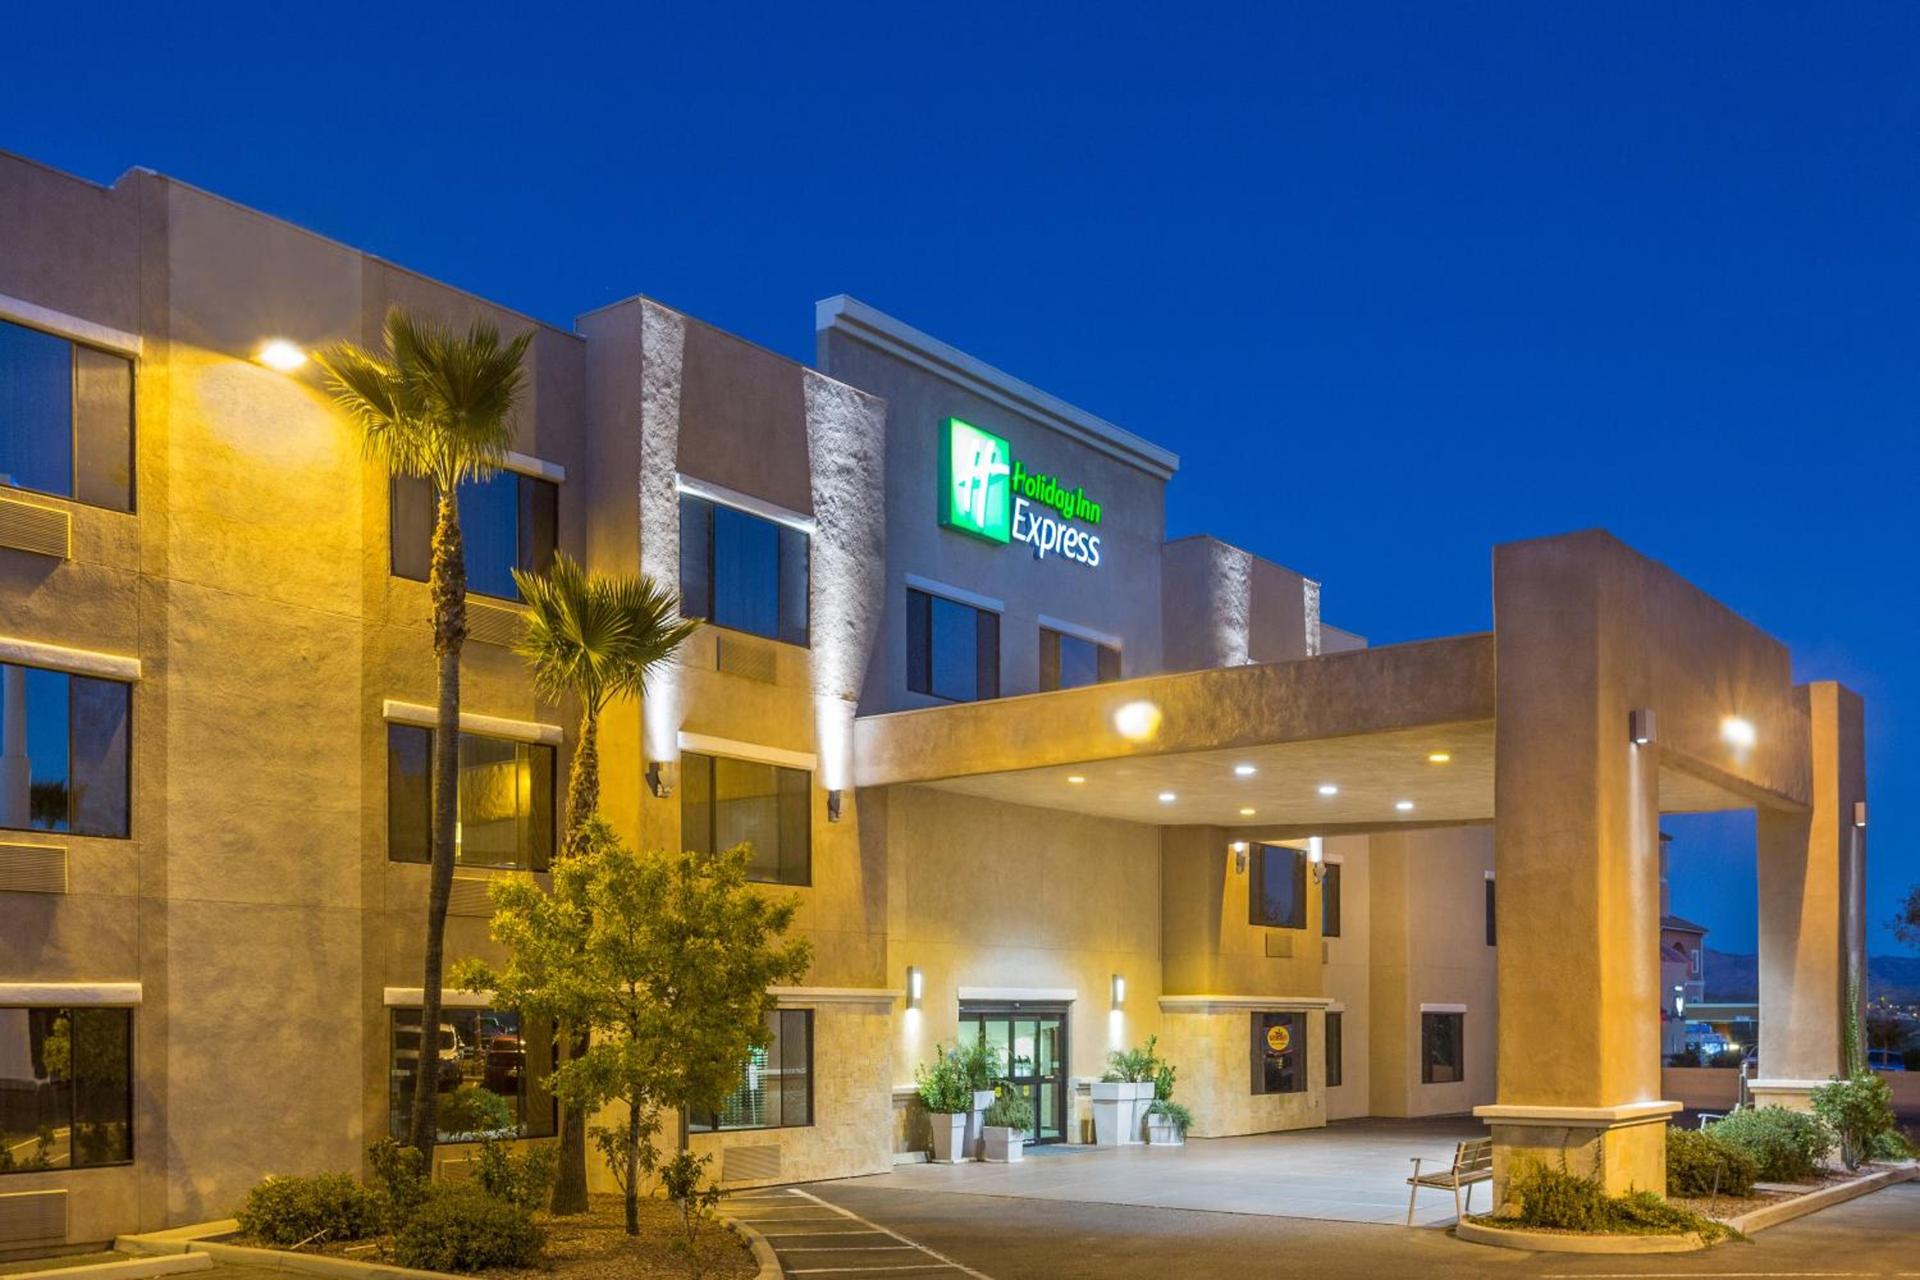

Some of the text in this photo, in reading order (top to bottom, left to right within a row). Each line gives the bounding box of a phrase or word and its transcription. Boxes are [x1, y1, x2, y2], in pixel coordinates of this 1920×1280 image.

[1012, 461, 1101, 523] Holiday Inn
[1012, 497, 1100, 567] Express
